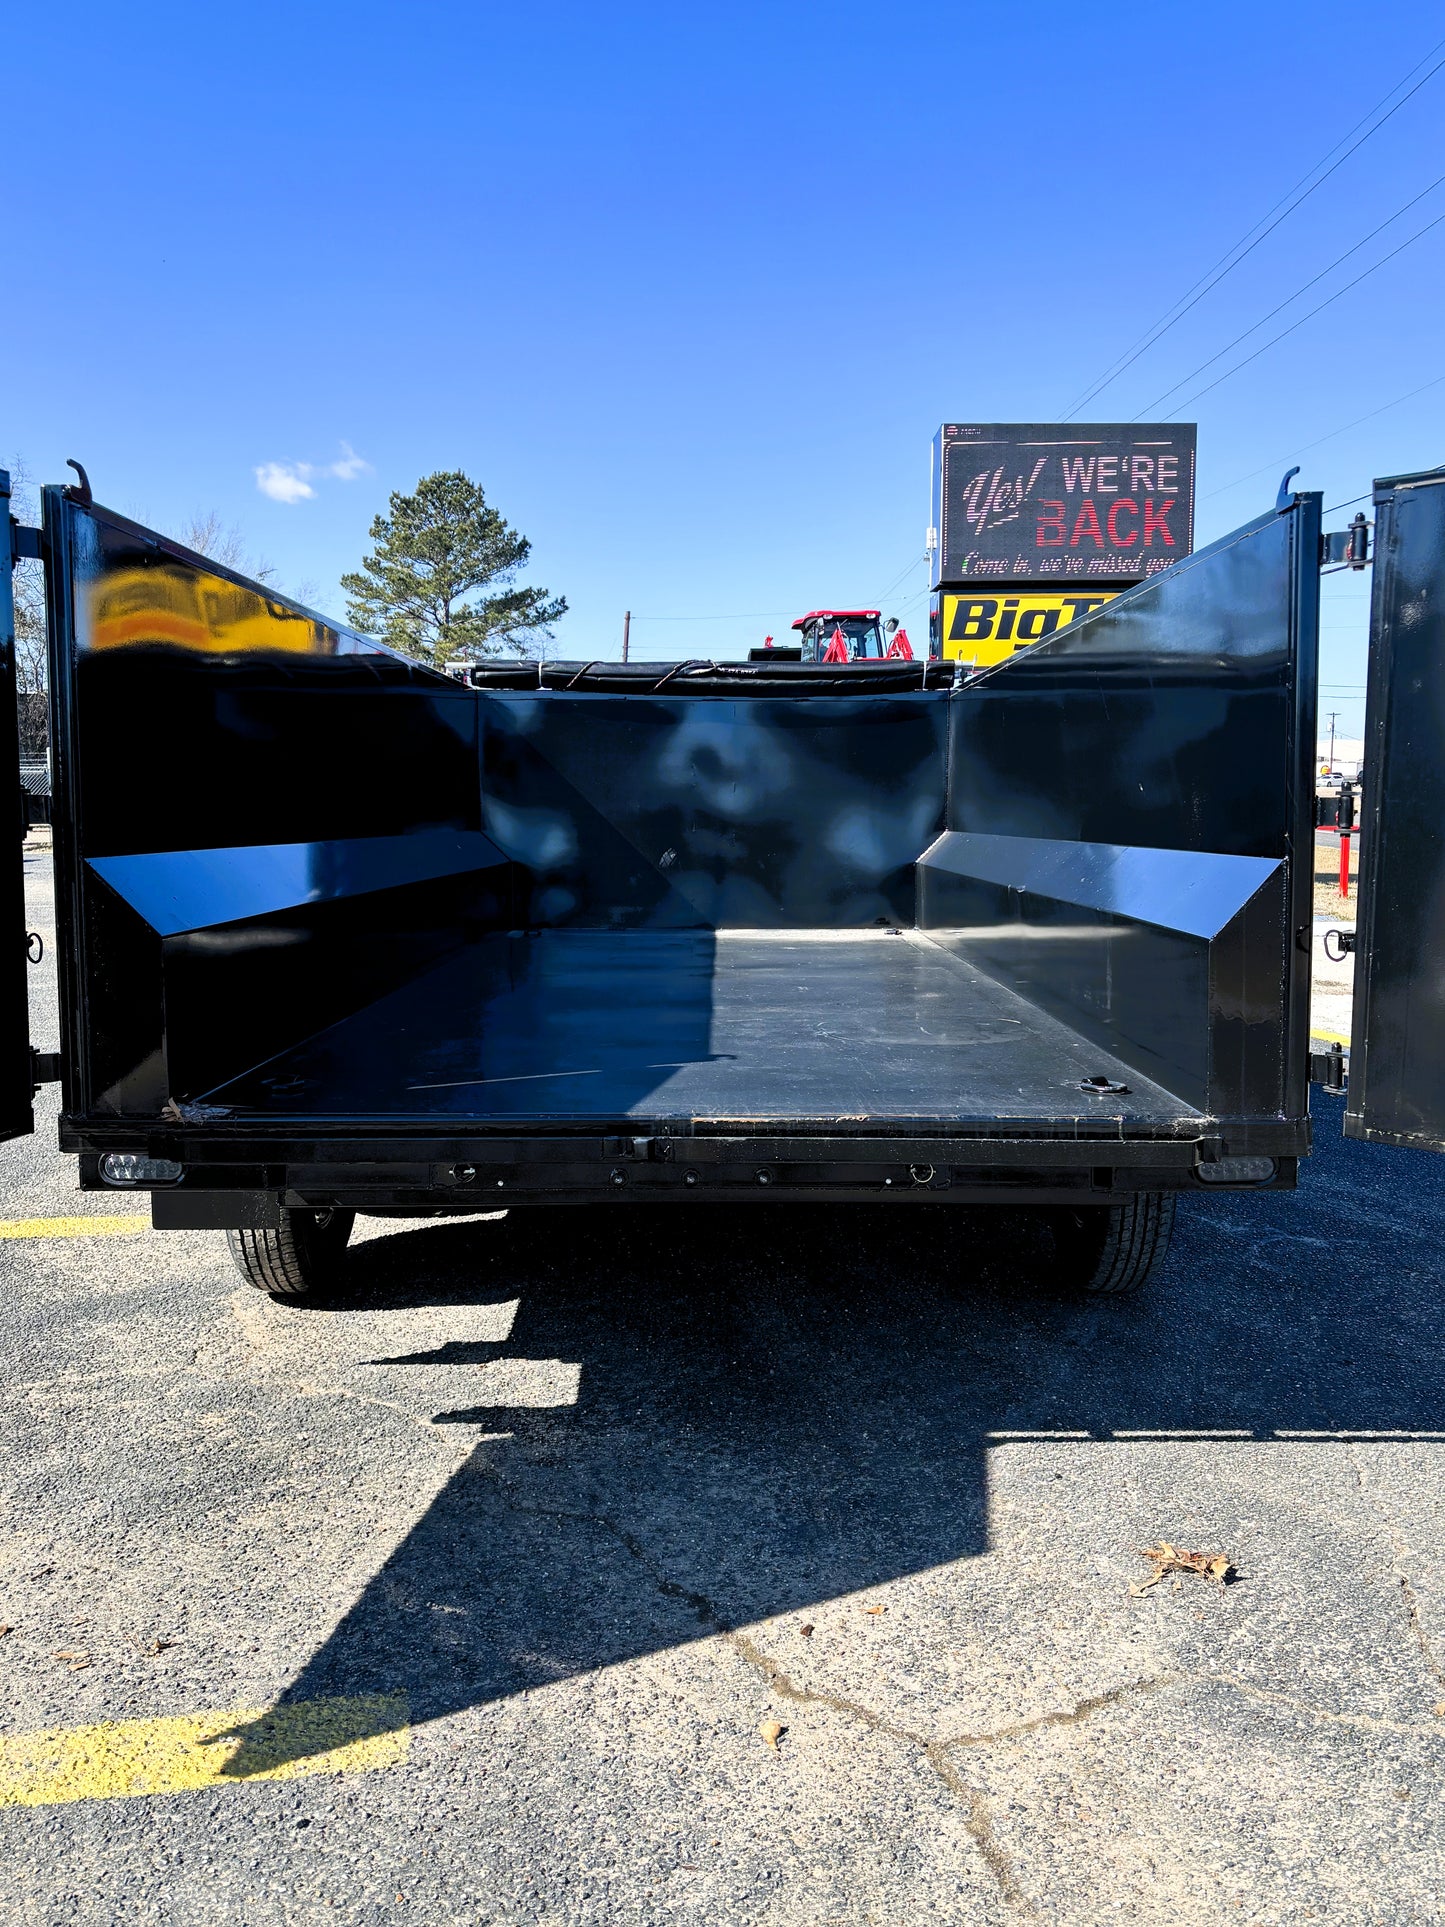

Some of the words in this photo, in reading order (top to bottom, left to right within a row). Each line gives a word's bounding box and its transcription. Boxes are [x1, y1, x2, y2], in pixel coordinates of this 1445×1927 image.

[962, 456, 1048, 535] Yes!
[1062, 456, 1179, 493] WE'RE
[1036, 498, 1176, 548] BACK
[961, 551, 1009, 575] Come
[1039, 555, 1083, 573] we've
[1086, 550, 1144, 573] missed
